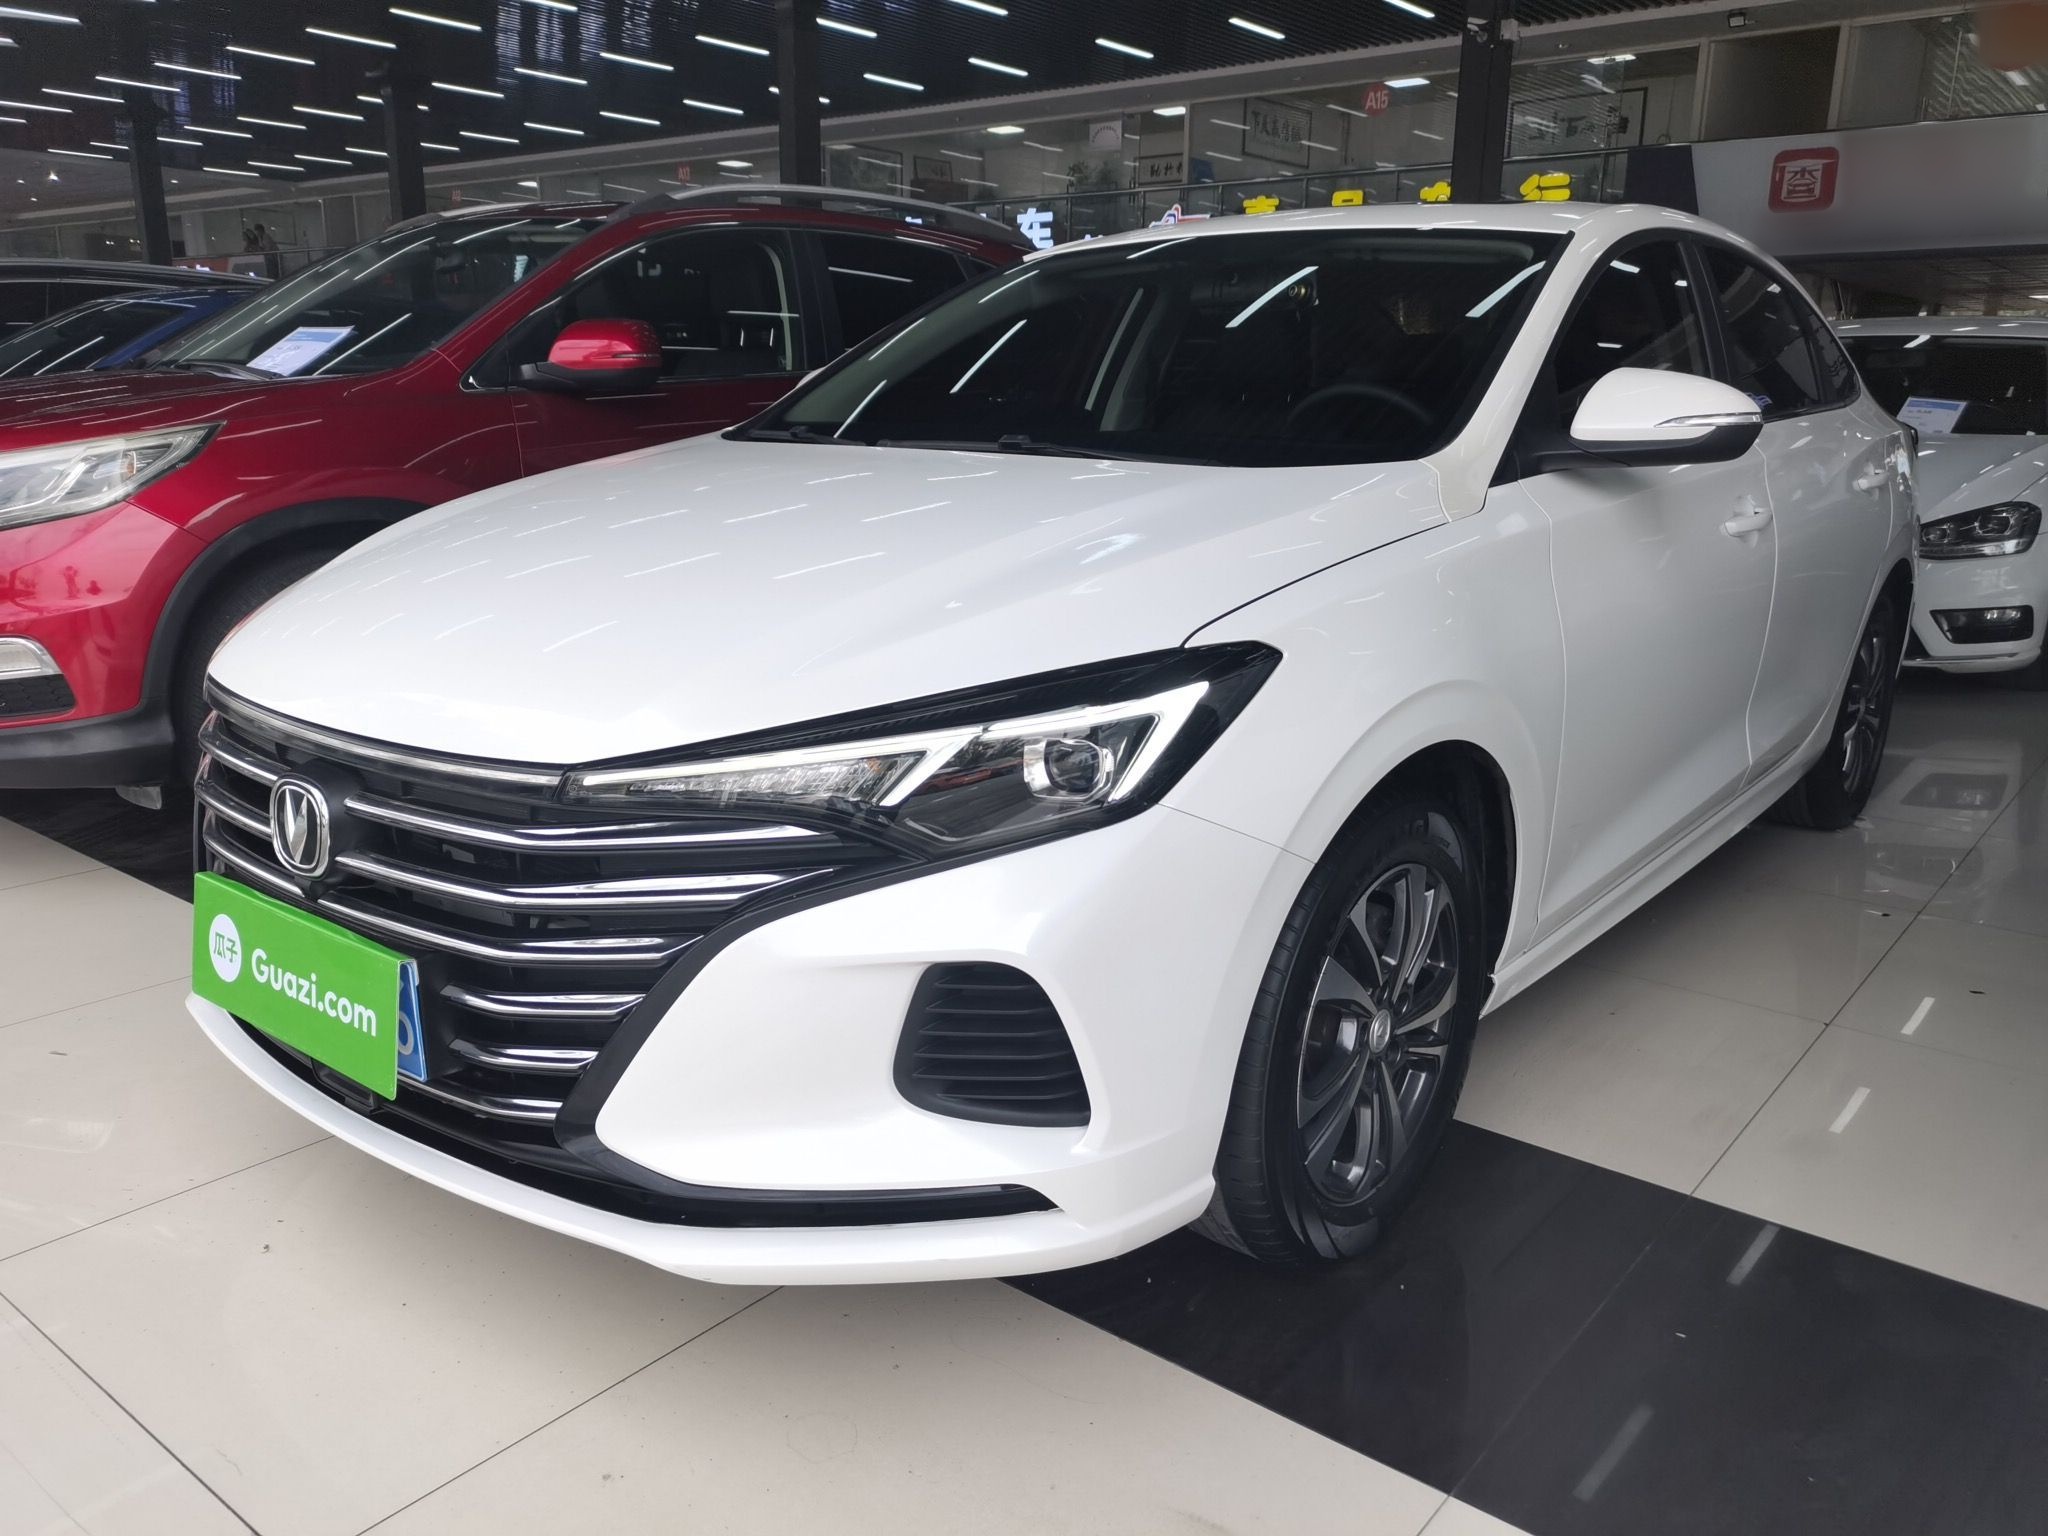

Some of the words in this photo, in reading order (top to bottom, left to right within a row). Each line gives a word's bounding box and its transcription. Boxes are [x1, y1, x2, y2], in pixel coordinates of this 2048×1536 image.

[1364, 90, 1389, 111] A15
[213, 932, 238, 963] 瓜子
[251, 948, 377, 1037] Guazi.com
